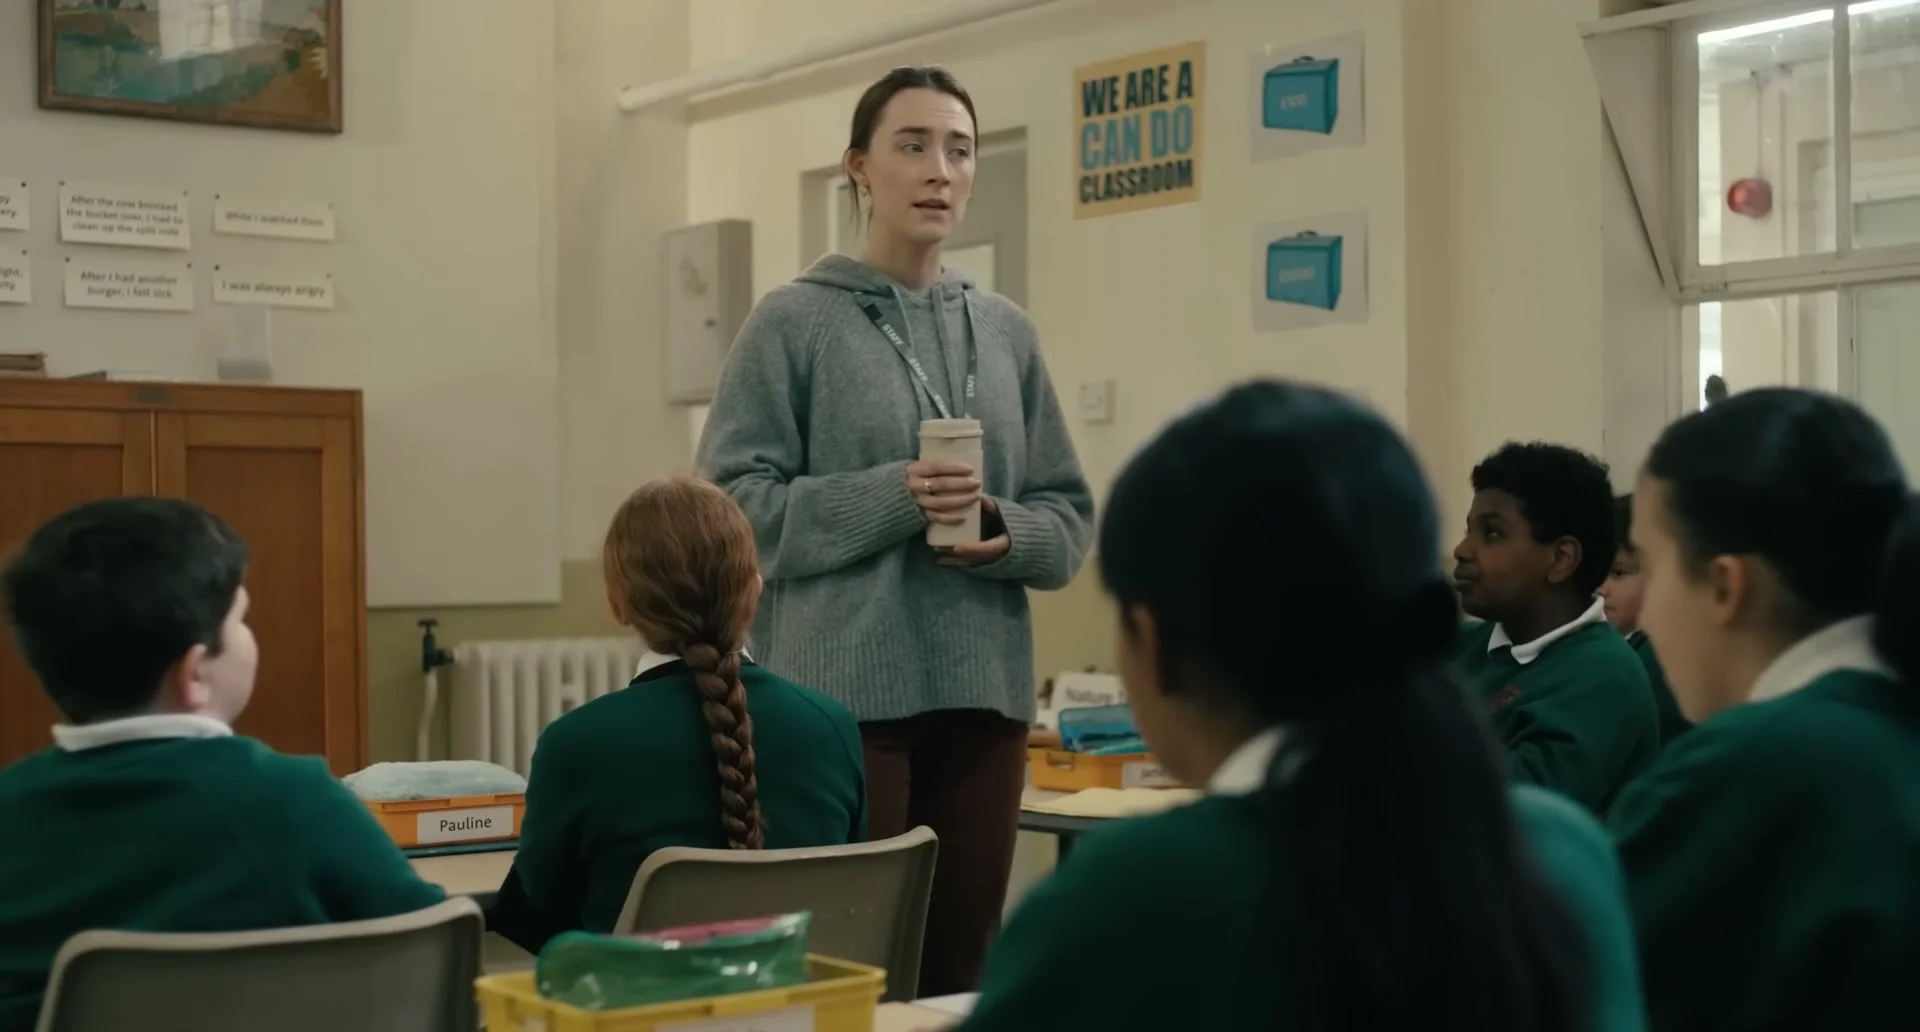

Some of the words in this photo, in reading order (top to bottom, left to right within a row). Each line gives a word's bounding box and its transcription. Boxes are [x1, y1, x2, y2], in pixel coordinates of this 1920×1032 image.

[1082, 75, 1121, 118] WE
[1125, 64, 1170, 110] ARE
[1176, 60, 1194, 100] A
[1080, 113, 1142, 171] CAN
[1150, 104, 1194, 160] DO
[1079, 160, 1193, 204] CLASSROOM
[71, 195, 95, 206] After
[80, 271, 106, 282] After
[115, 272, 135, 283] had
[229, 282, 251, 292] was
[254, 281, 291, 297] always
[294, 286, 325, 298] angry
[882, 323, 904, 346] STAFF
[965, 374, 976, 398] STAFF
[439, 816, 493, 833] Pauline
